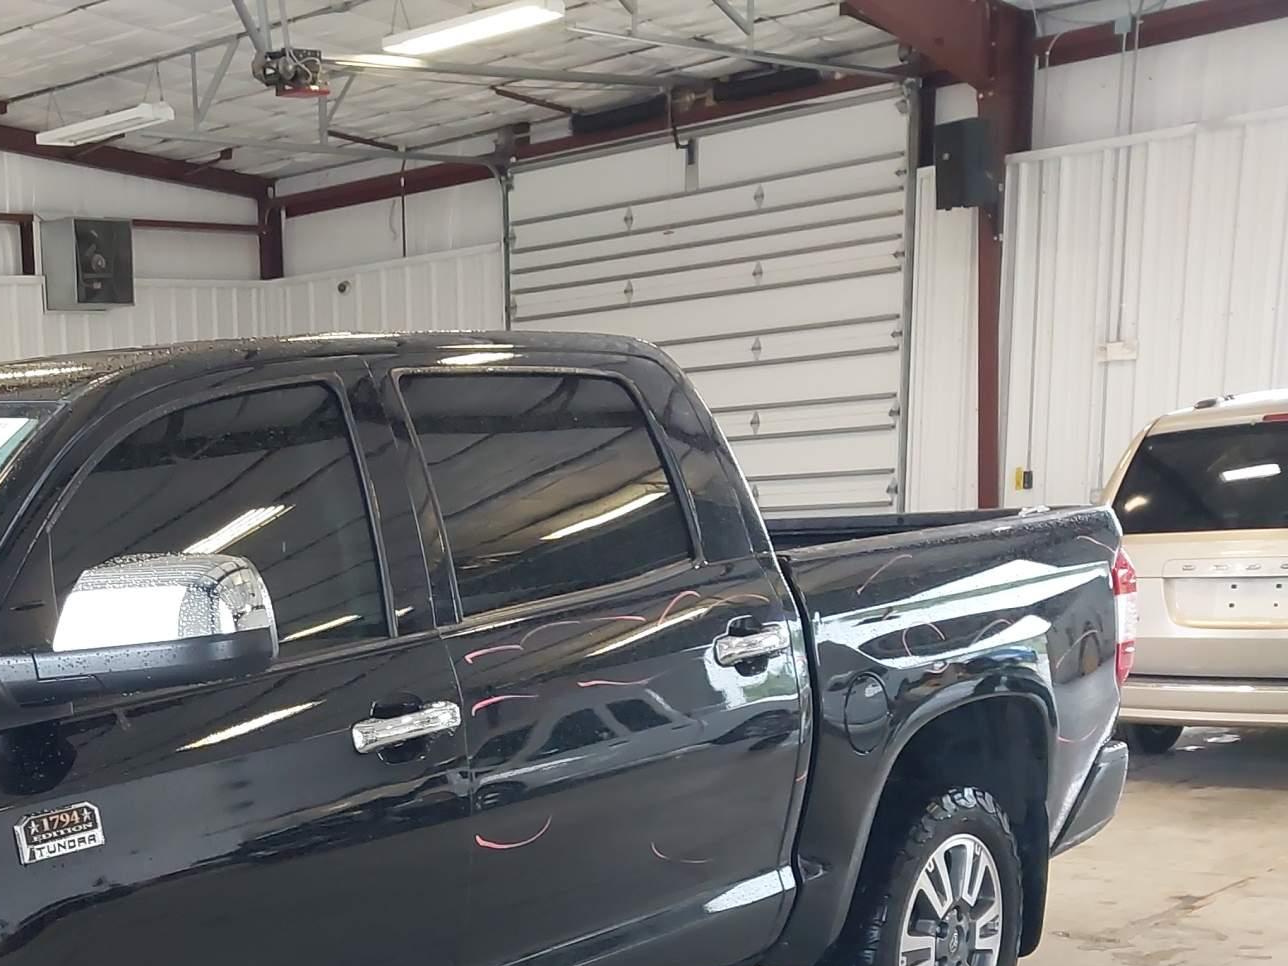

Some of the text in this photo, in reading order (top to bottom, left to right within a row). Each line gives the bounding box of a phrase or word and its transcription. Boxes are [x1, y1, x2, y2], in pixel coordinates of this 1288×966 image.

[40, 810, 81, 832] 1794
[32, 822, 94, 843] EDITION
[36, 834, 97, 858] TUNDRA
